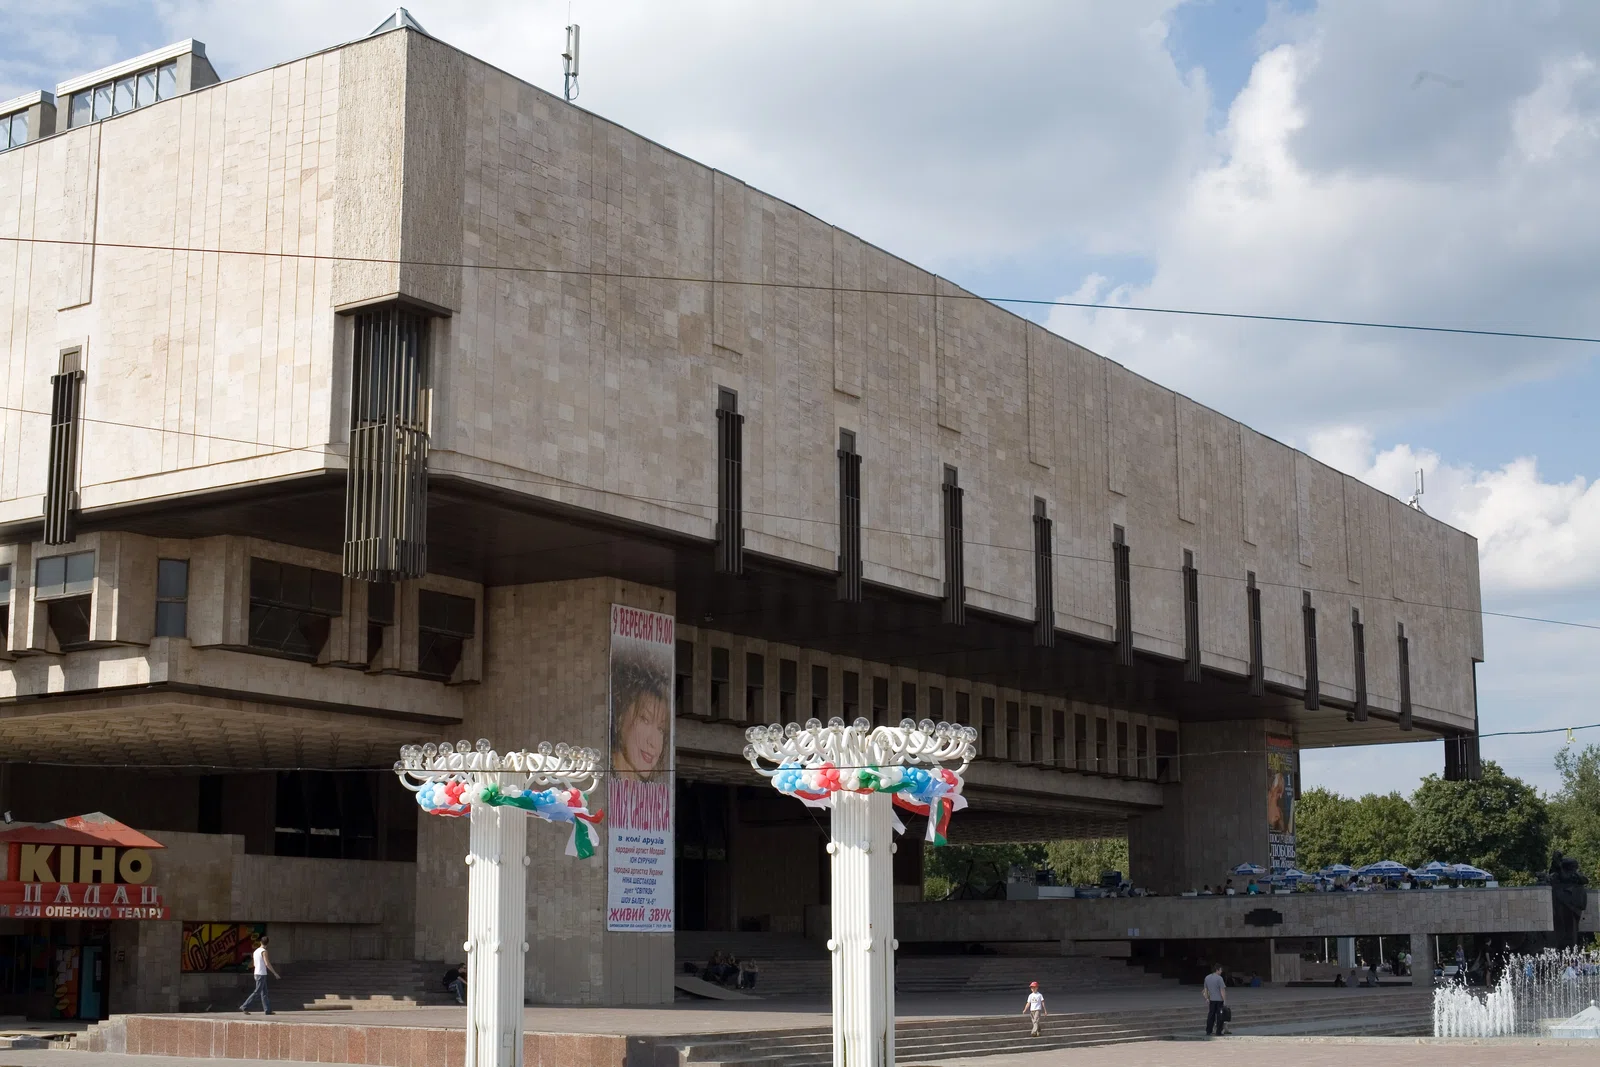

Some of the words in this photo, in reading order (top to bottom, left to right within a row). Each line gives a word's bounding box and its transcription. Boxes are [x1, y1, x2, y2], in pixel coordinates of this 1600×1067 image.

[620, 608, 654, 641] ВЕРЕСНЯ
[656, 616, 672, 644] 19.00
[625, 835, 641, 843] колі
[642, 836, 664, 845] друзів
[19, 844, 153, 884] КІНО
[23, 883, 160, 906] ПАЛАЦ
[14, 905, 41, 917] ЗАЛ
[45, 905, 111, 918] ОПЕРНОГО
[117, 906, 165, 919] ТЕАТРУ
[609, 906, 645, 922] ЖИВИЙ
[648, 908, 672, 922] ЗВУК
